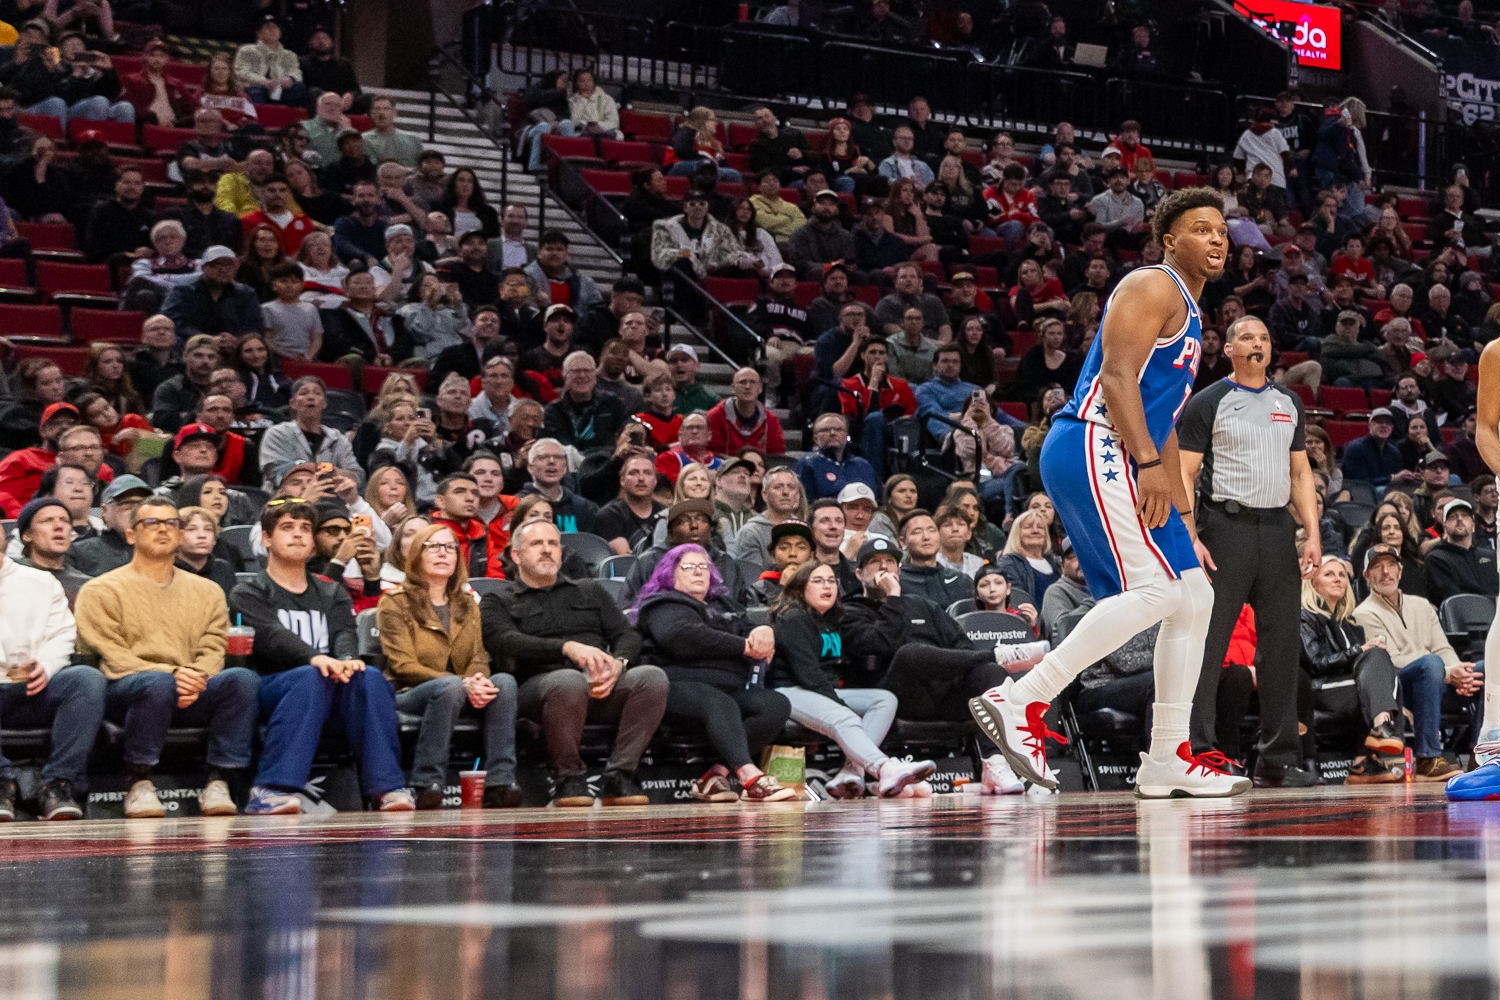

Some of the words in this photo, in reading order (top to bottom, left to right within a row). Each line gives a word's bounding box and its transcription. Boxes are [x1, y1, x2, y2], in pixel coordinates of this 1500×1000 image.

[1098, 765, 1129, 775] SPIRIT
[1320, 759, 1355, 770] MOUNT
[925, 771, 975, 783] OUNTAIN
[1323, 769, 1349, 779] ASINO
[641, 779, 679, 790] SPIRIT
